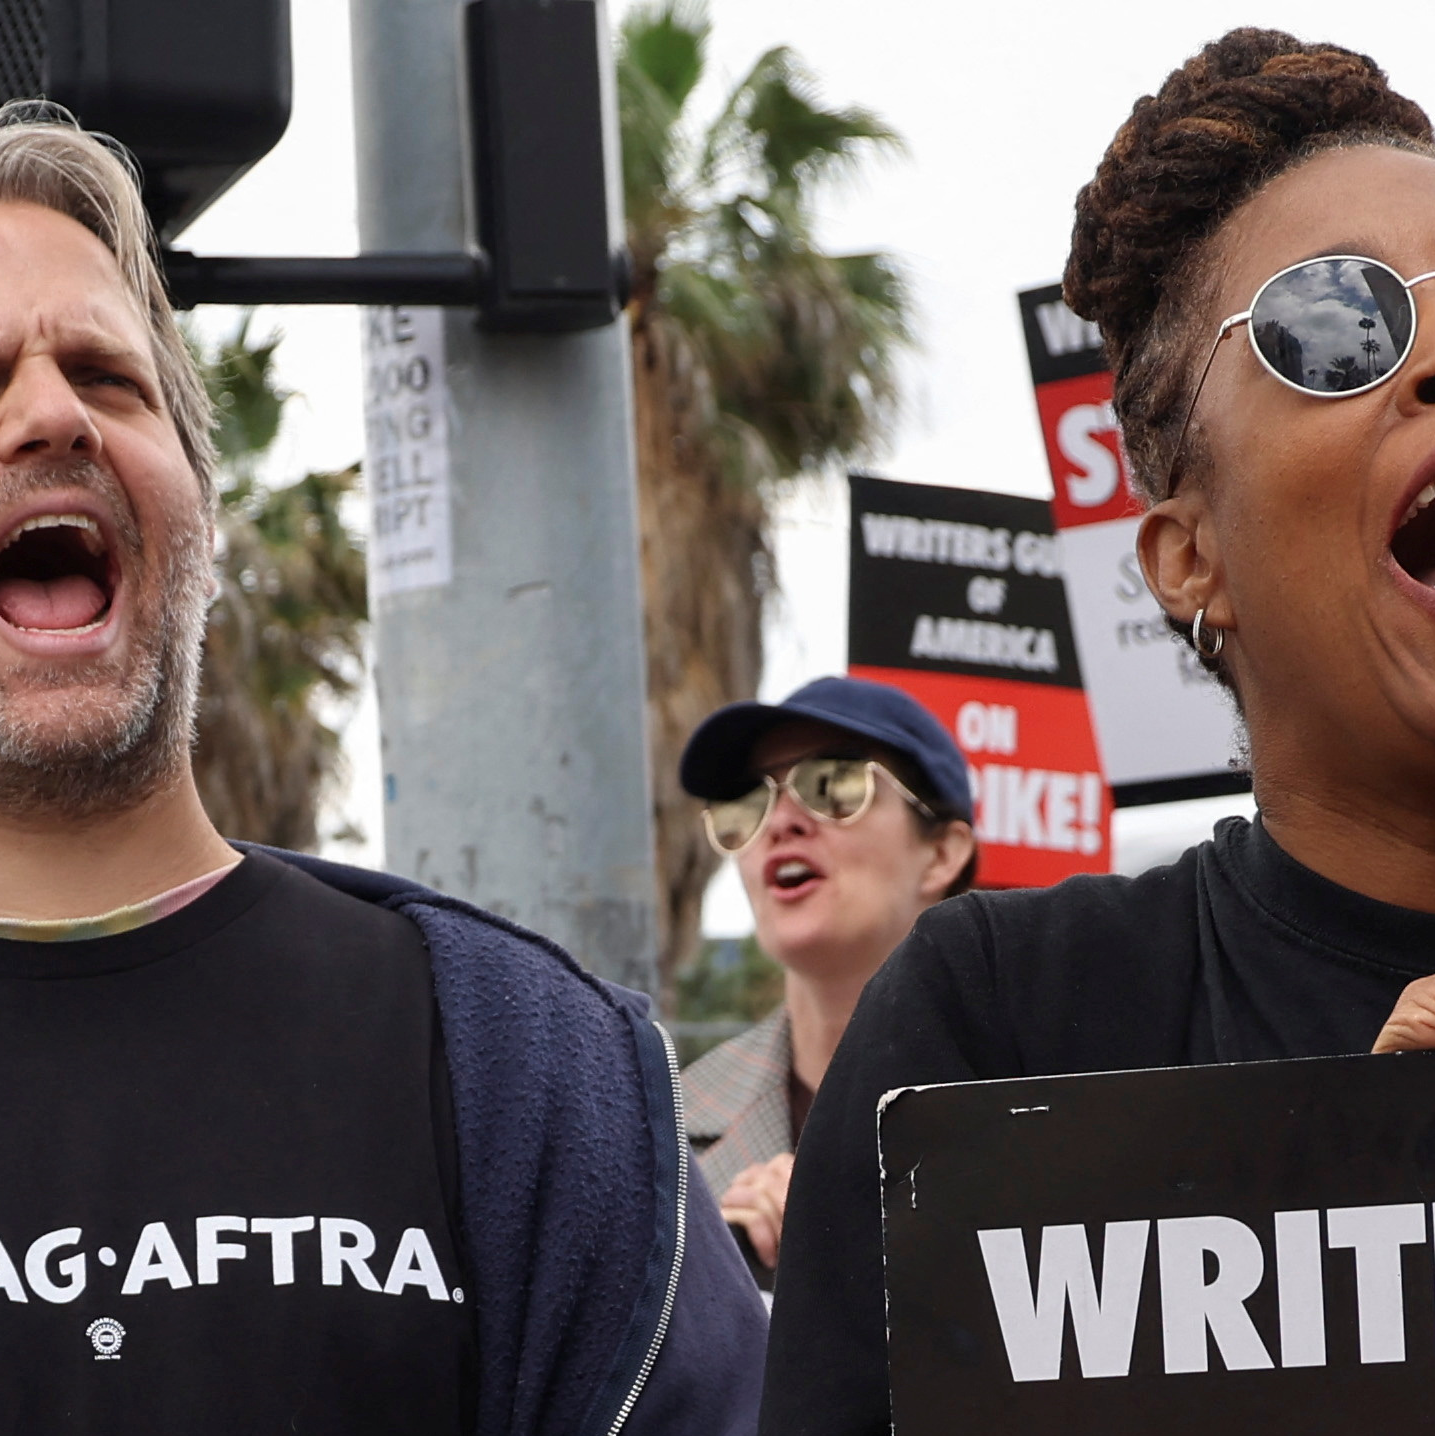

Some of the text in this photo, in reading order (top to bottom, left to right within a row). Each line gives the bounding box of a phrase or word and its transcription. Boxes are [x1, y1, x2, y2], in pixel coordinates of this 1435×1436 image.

[861, 512, 1011, 571] WRITERS
[967, 576, 1006, 614] OF
[911, 615, 1059, 673] AMERICA
[957, 701, 1018, 754] ON
[969, 765, 1102, 856] IKE!
